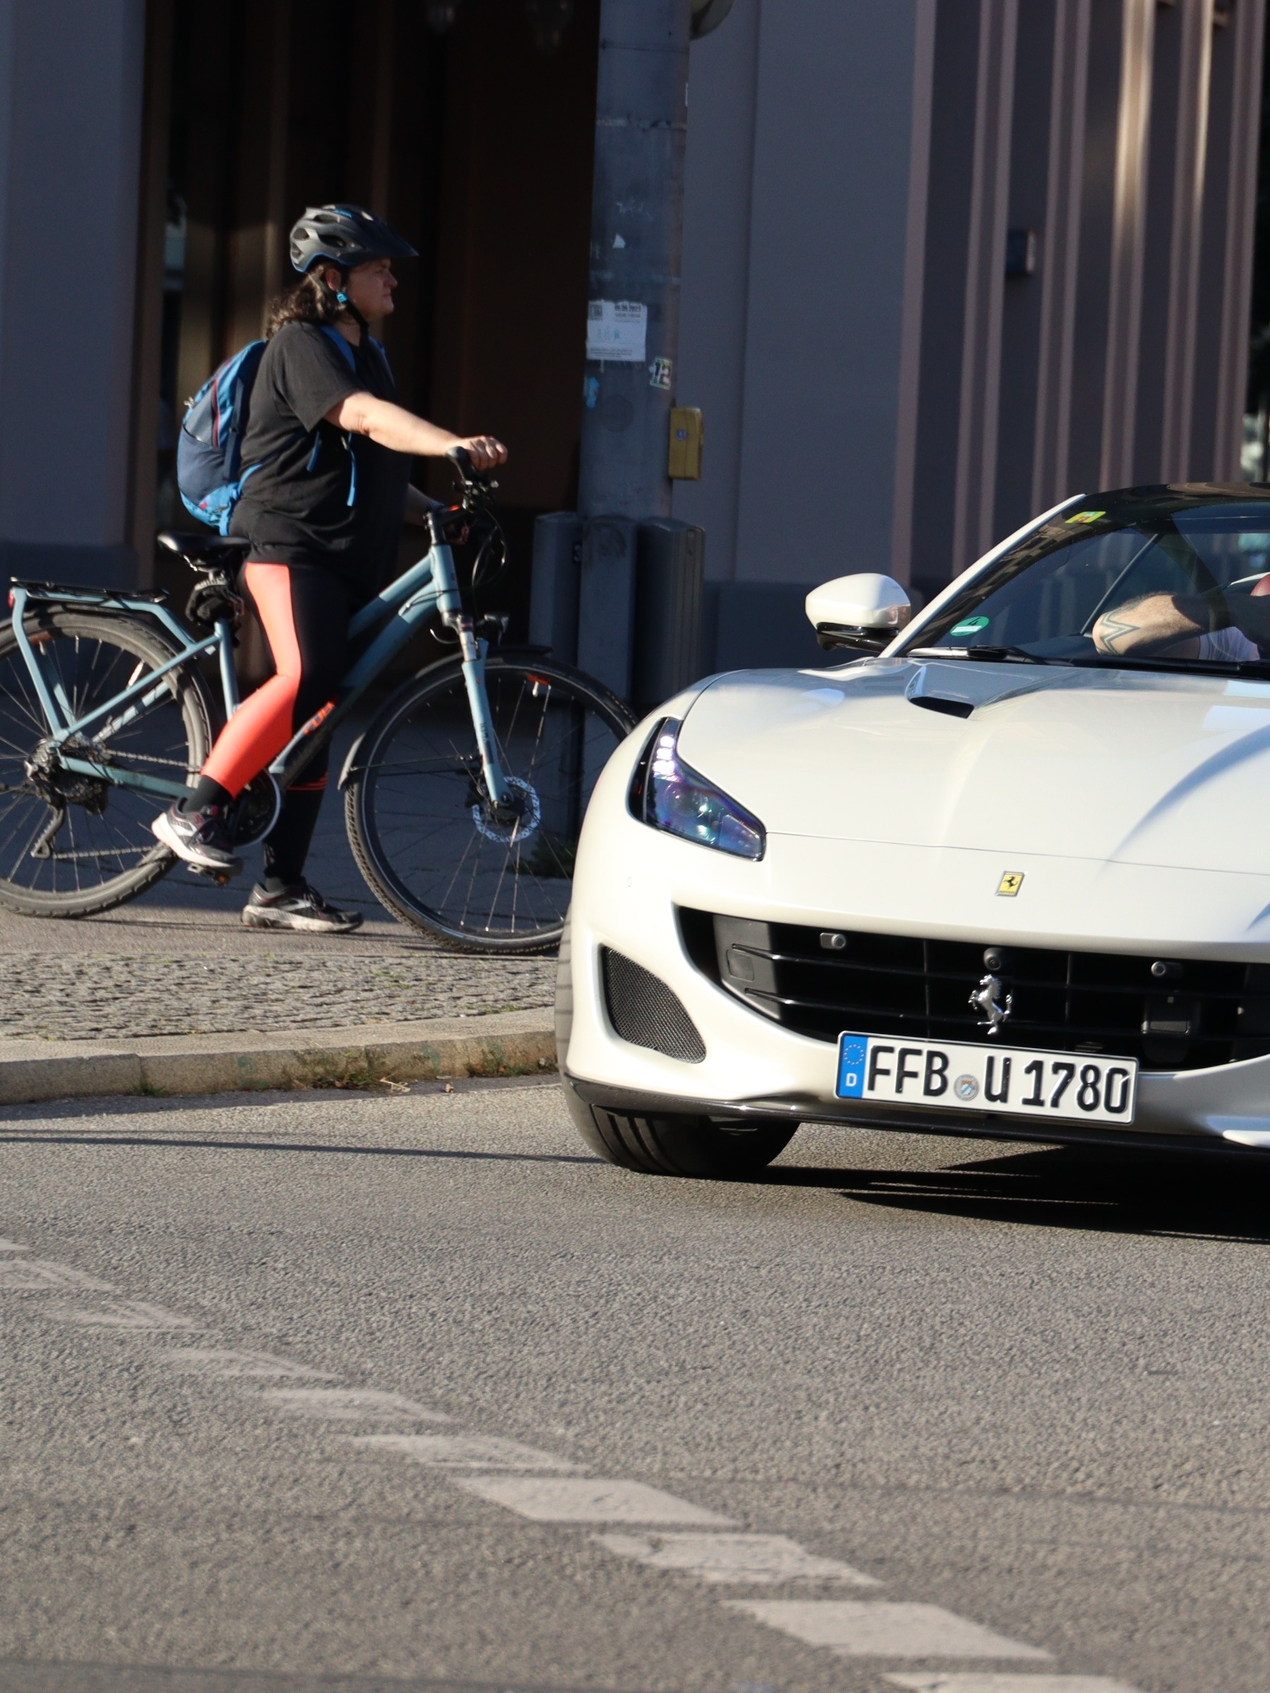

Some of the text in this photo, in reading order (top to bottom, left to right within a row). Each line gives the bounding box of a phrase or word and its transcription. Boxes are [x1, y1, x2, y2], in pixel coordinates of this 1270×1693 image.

[845, 1073, 857, 1087] D
[866, 1045, 1130, 1113] FFB U 1780
